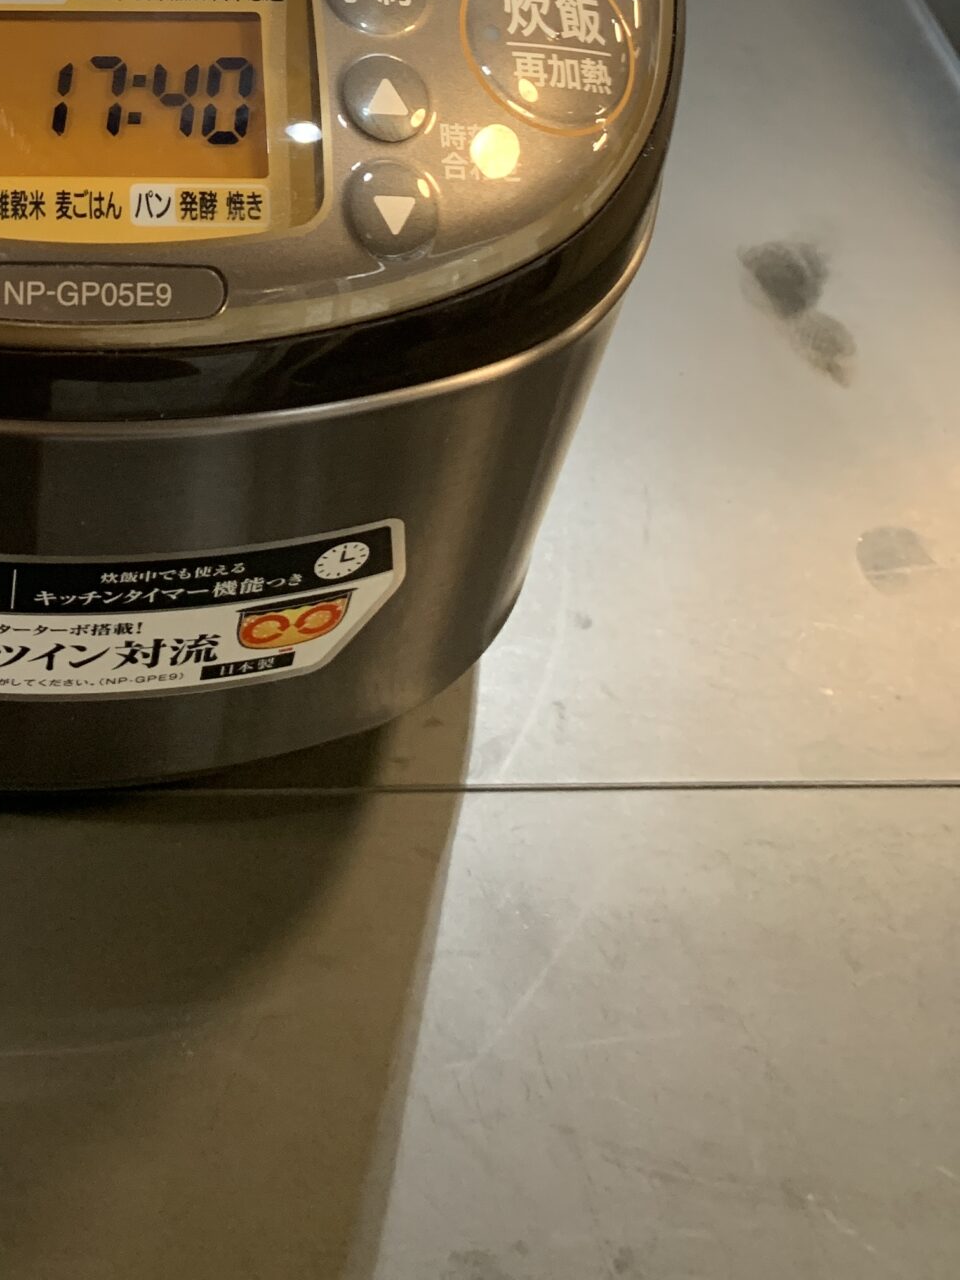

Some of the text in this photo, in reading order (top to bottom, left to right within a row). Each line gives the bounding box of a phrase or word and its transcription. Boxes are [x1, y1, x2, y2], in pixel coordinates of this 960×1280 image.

[512, 52, 613, 95] 再加熱
[51, 55, 255, 145] 17:40
[55, 190, 122, 221] 麦ごはん
[135, 193, 172, 219] パン
[178, 192, 218, 221] 発酵
[226, 192, 263, 221] 焼き
[4, 281, 173, 307] NP-GP05E9
[100, 562, 246, 585] 炊飯中でも使える
[33, 574, 303, 607] キッチンタイマー機能つき
